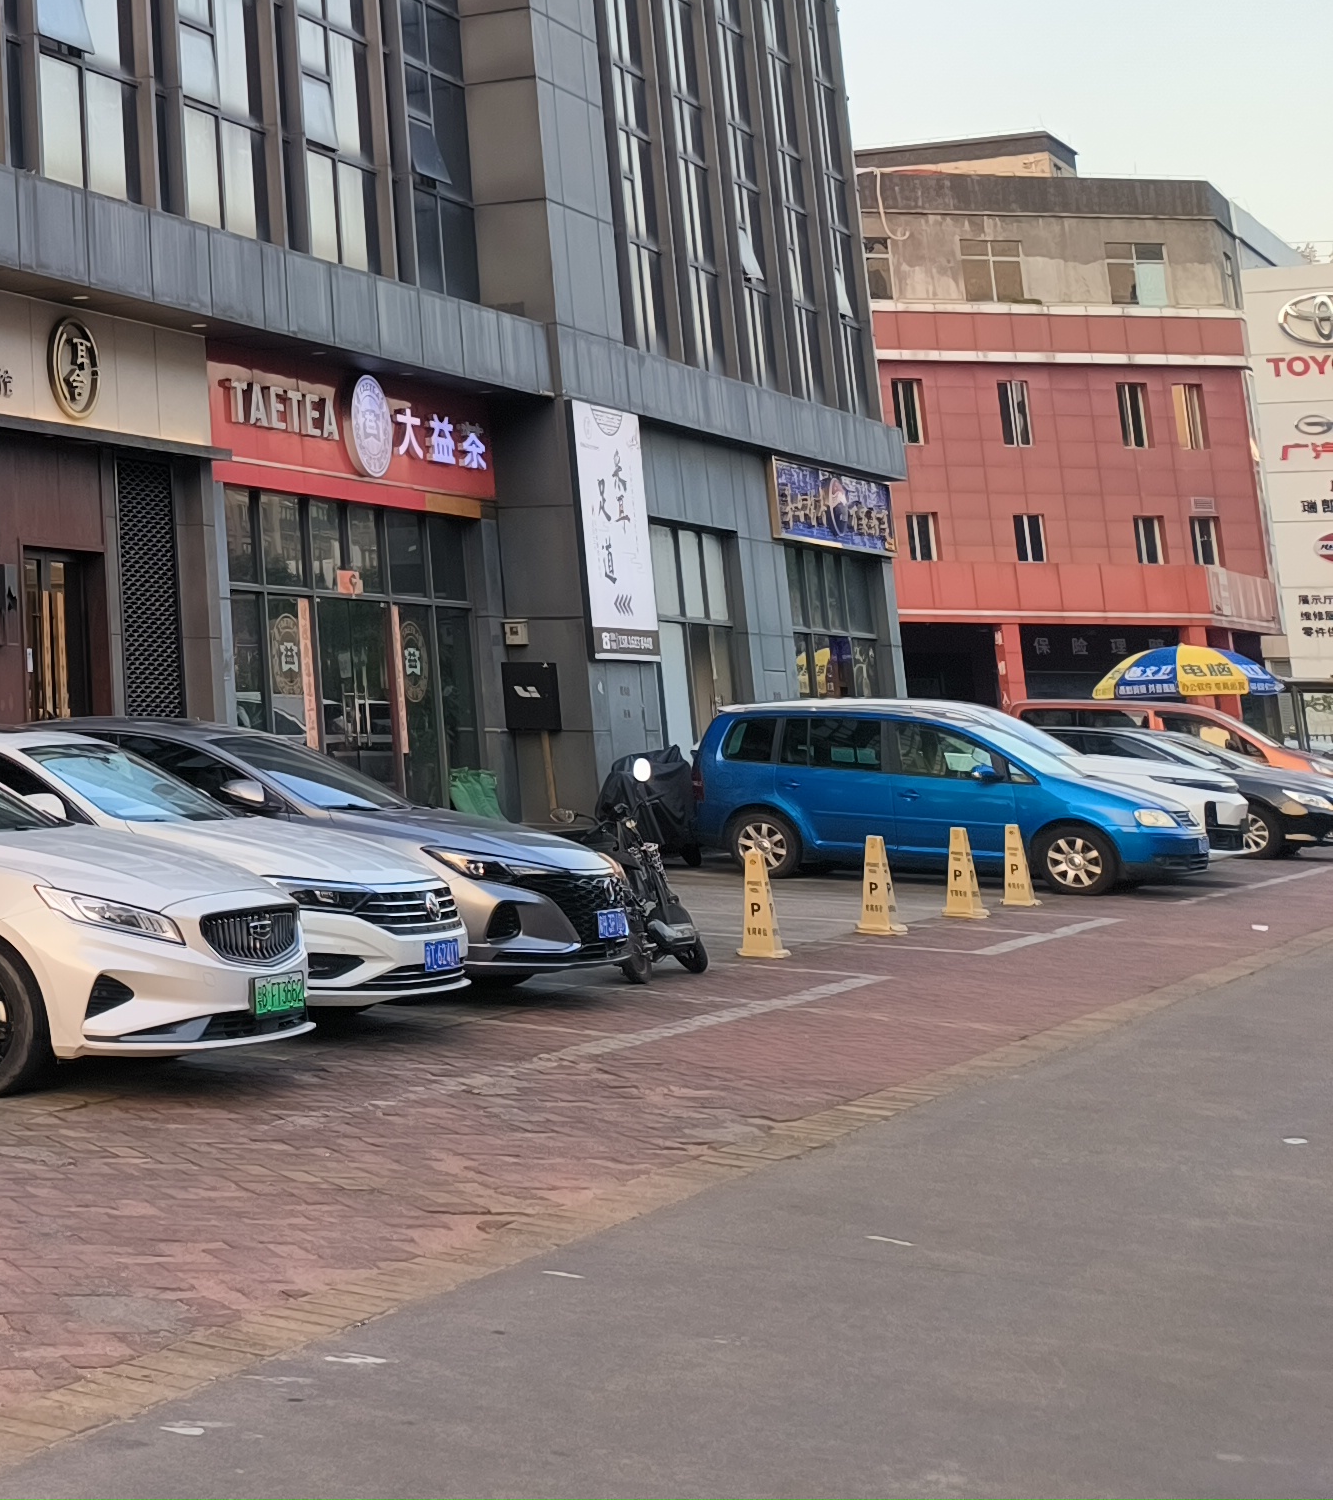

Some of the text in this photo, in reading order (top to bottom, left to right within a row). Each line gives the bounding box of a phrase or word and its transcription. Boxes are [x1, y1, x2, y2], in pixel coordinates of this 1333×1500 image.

[1266, 355, 1333, 378] TOY
[230, 381, 340, 441] TAETEA
[394, 407, 487, 471] 大益茶
[1180, 662, 1234, 678] 电脑
[869, 881, 878, 895] P
[751, 902, 761, 917] P
